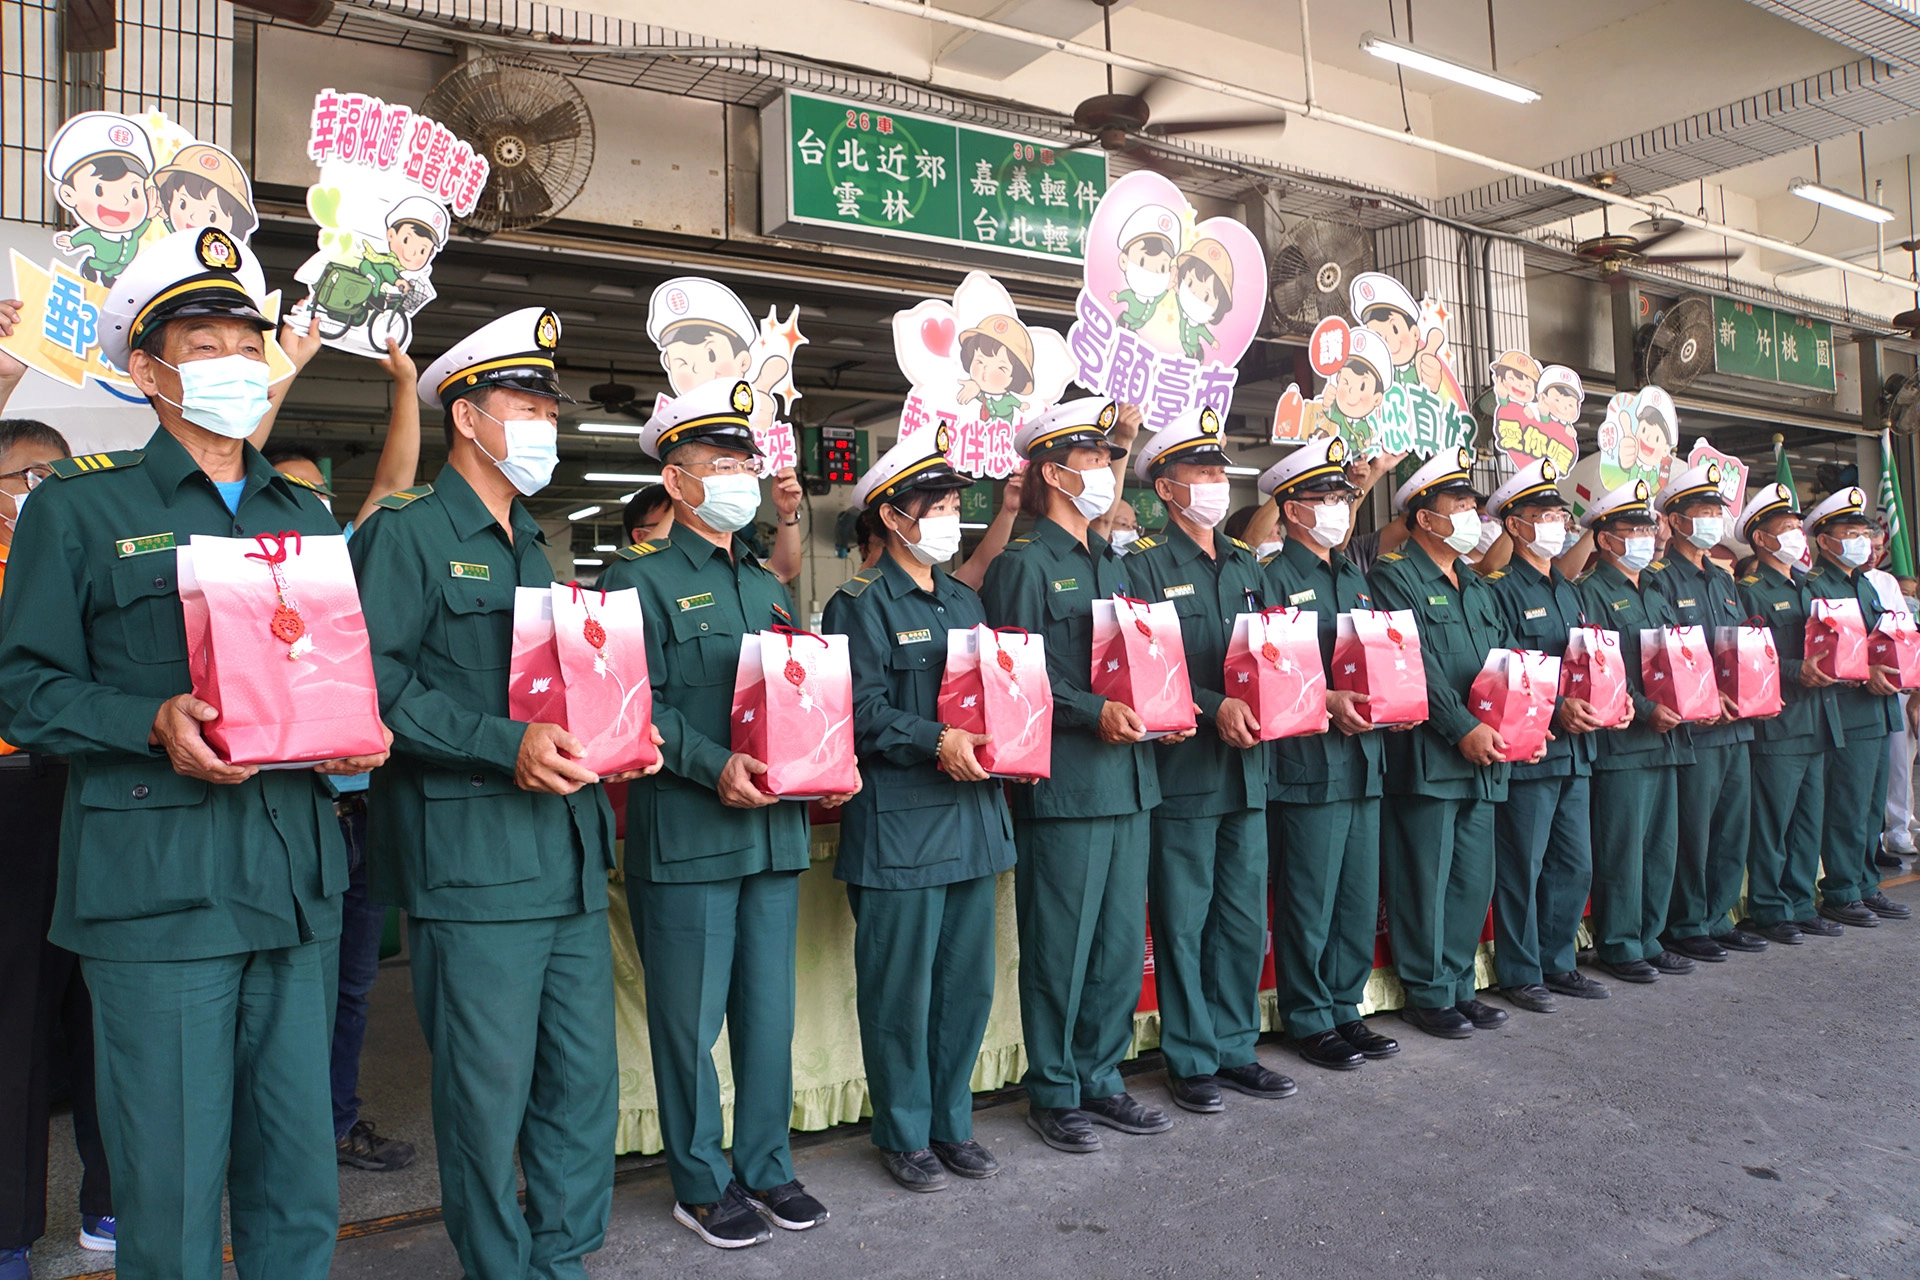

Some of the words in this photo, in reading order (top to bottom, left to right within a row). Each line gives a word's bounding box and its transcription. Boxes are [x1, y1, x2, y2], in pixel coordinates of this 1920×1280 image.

[313, 93, 407, 167] 幸福快遞
[797, 128, 946, 188] 台北近郊
[833, 182, 915, 224] 雲林
[970, 159, 1101, 214] 嘉義輕件
[1719, 317, 1771, 358] 新竹
[1781, 331, 1830, 369] 桃園
